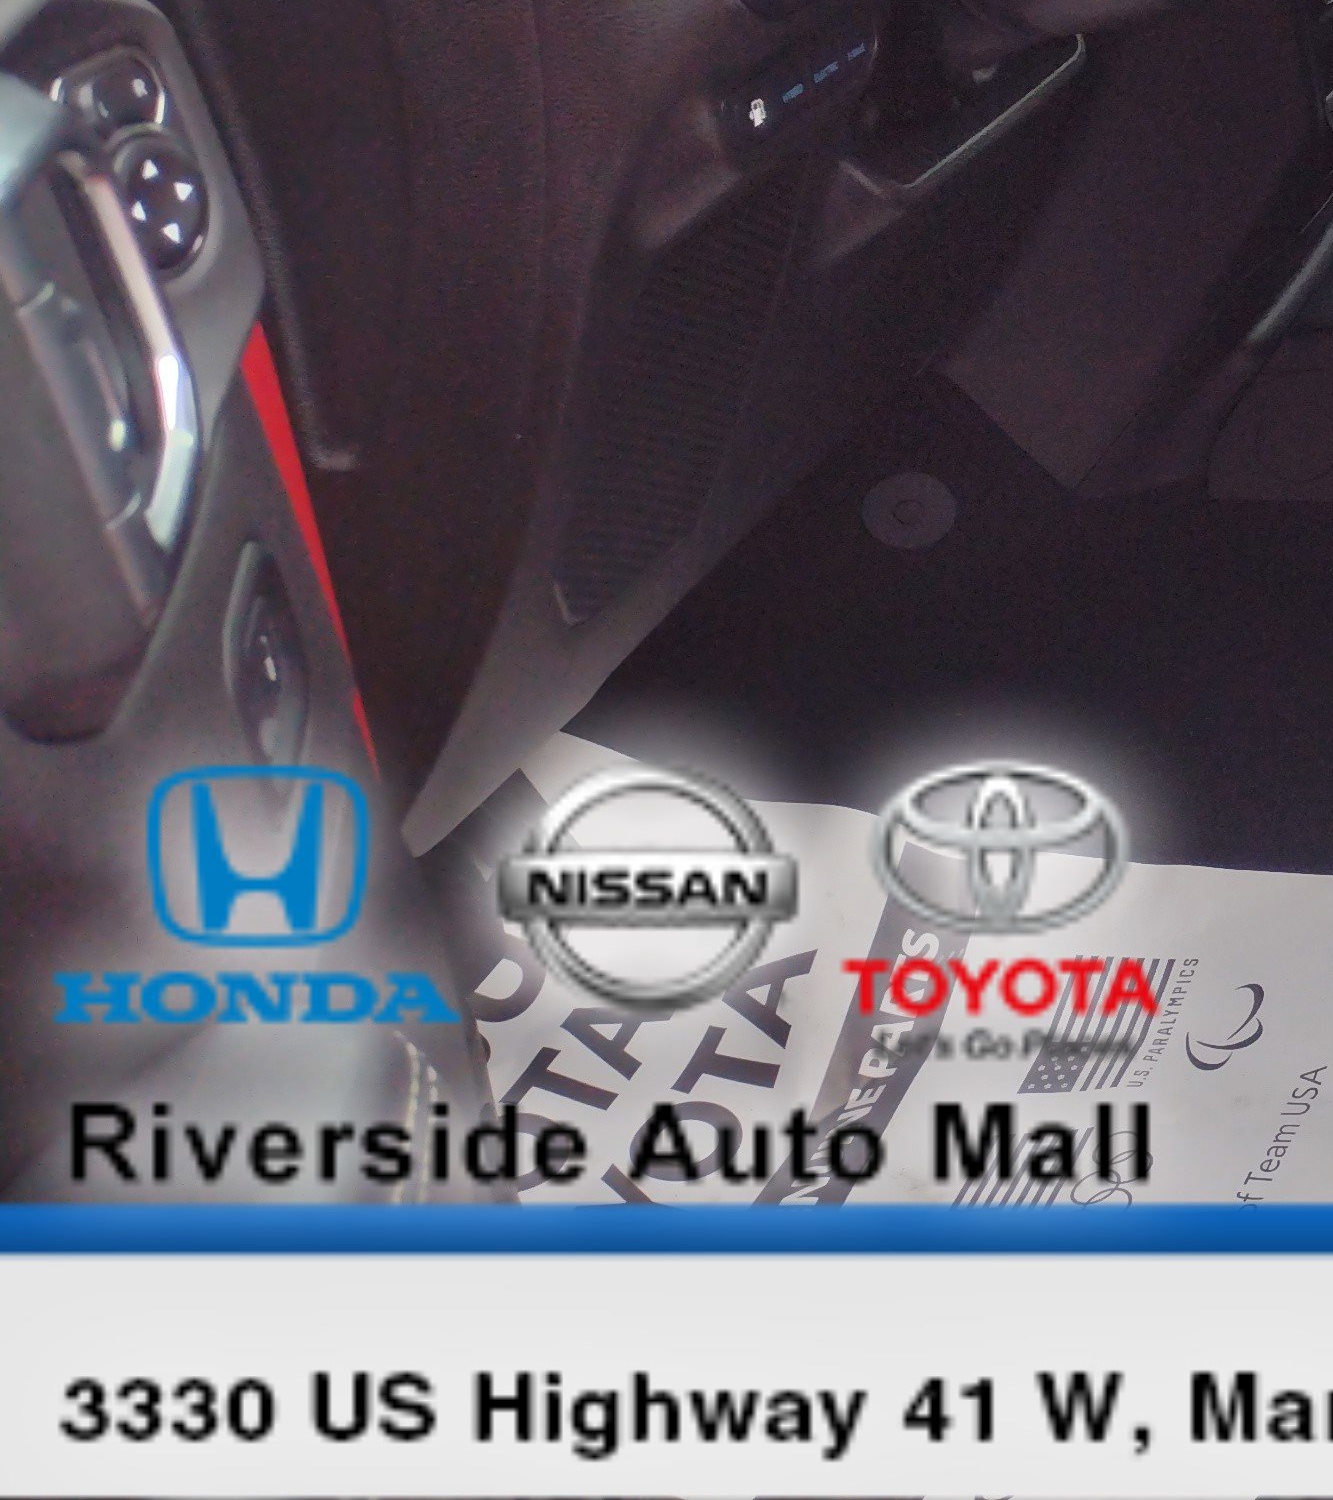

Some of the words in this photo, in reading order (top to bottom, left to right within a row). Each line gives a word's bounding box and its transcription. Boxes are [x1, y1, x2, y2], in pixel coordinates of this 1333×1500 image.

[1143, 958, 1200, 1062] PARALYMPICS
[1243, 1124, 1301, 1185] Team
[1280, 1065, 1328, 1116] USA
